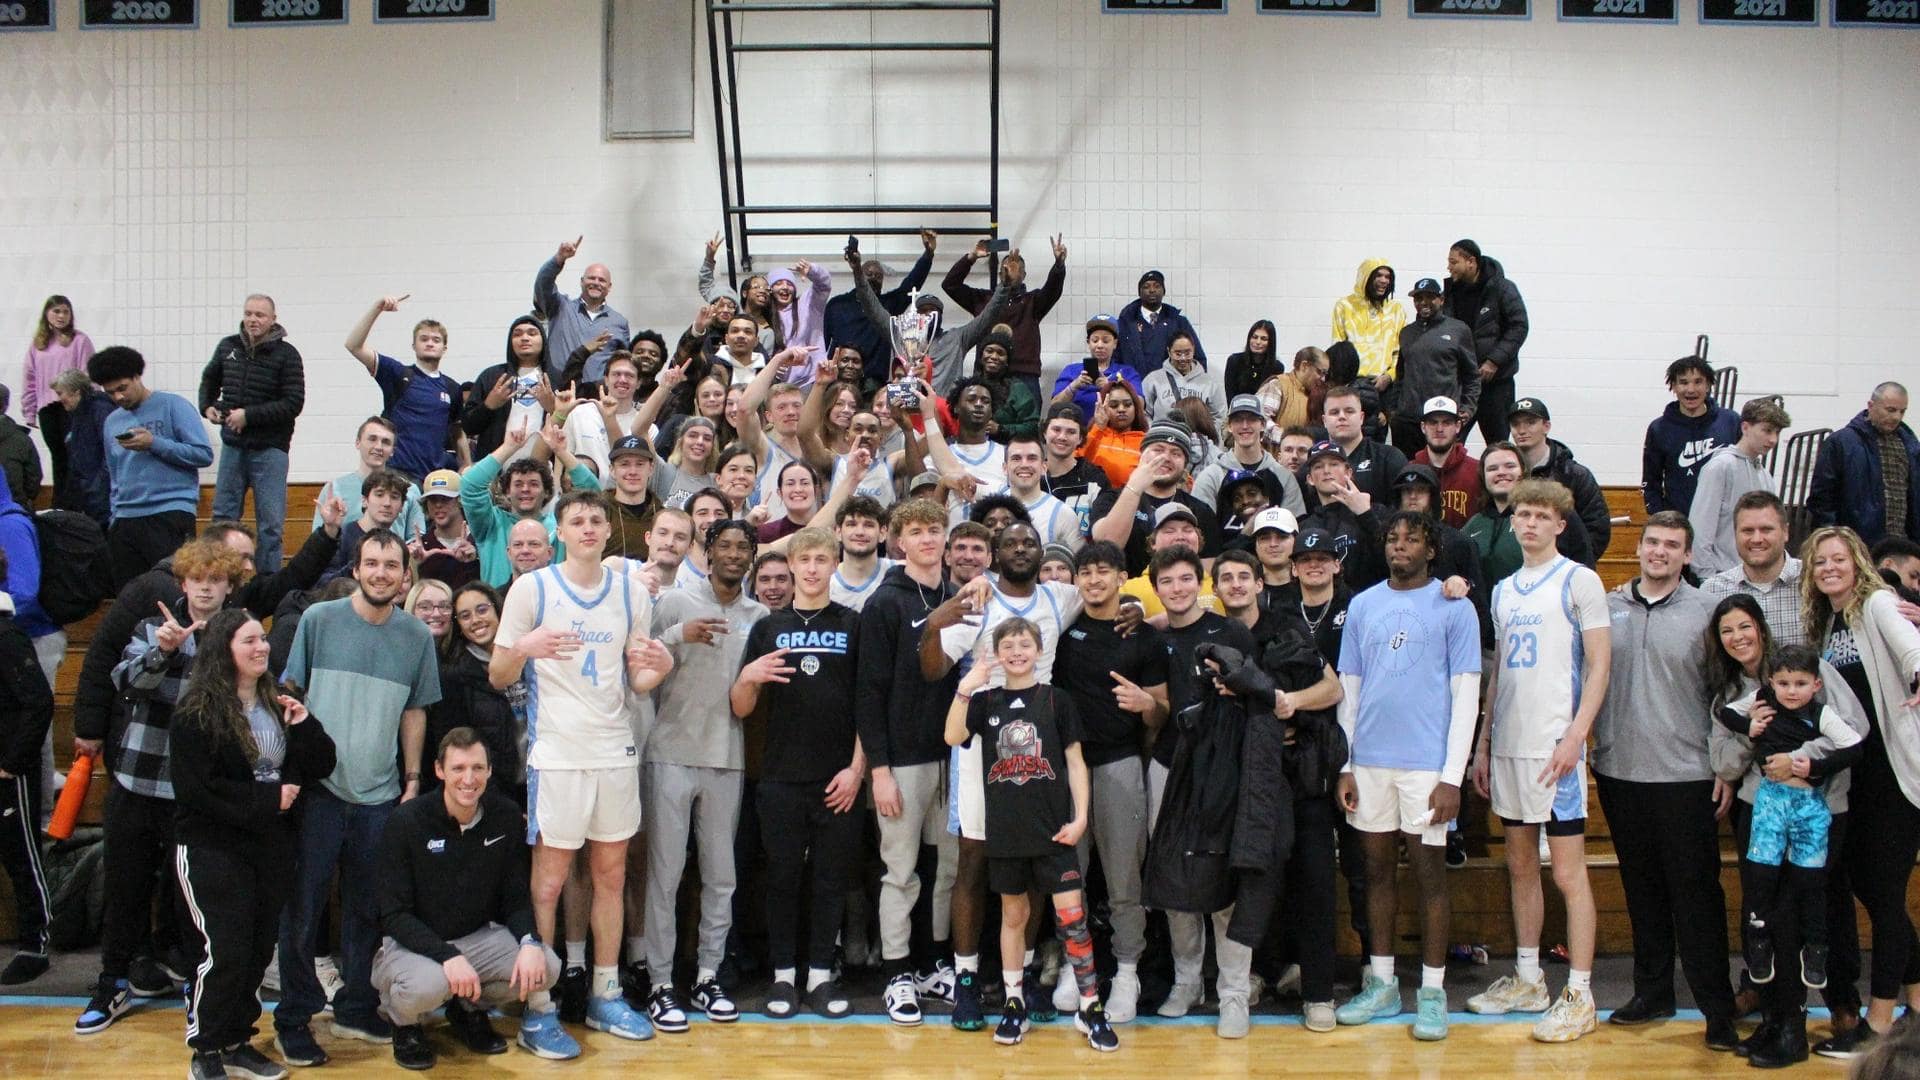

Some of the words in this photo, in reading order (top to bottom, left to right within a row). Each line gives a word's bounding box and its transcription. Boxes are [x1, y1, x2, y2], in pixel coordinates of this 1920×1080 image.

[112, 1, 170, 20] 2020
[262, 0, 320, 17] 2020
[407, 0, 465, 12] 2020
[1593, 0, 1645, 13] 2021
[1734, 0, 1786, 16] 2021
[1866, 0, 1918, 18] 2021
[1684, 437, 1714, 456] NIKE
[775, 631, 848, 649] GRACE
[1506, 632, 1538, 669] 23
[581, 650, 599, 687] 4
[988, 754, 1056, 784] SWISH
